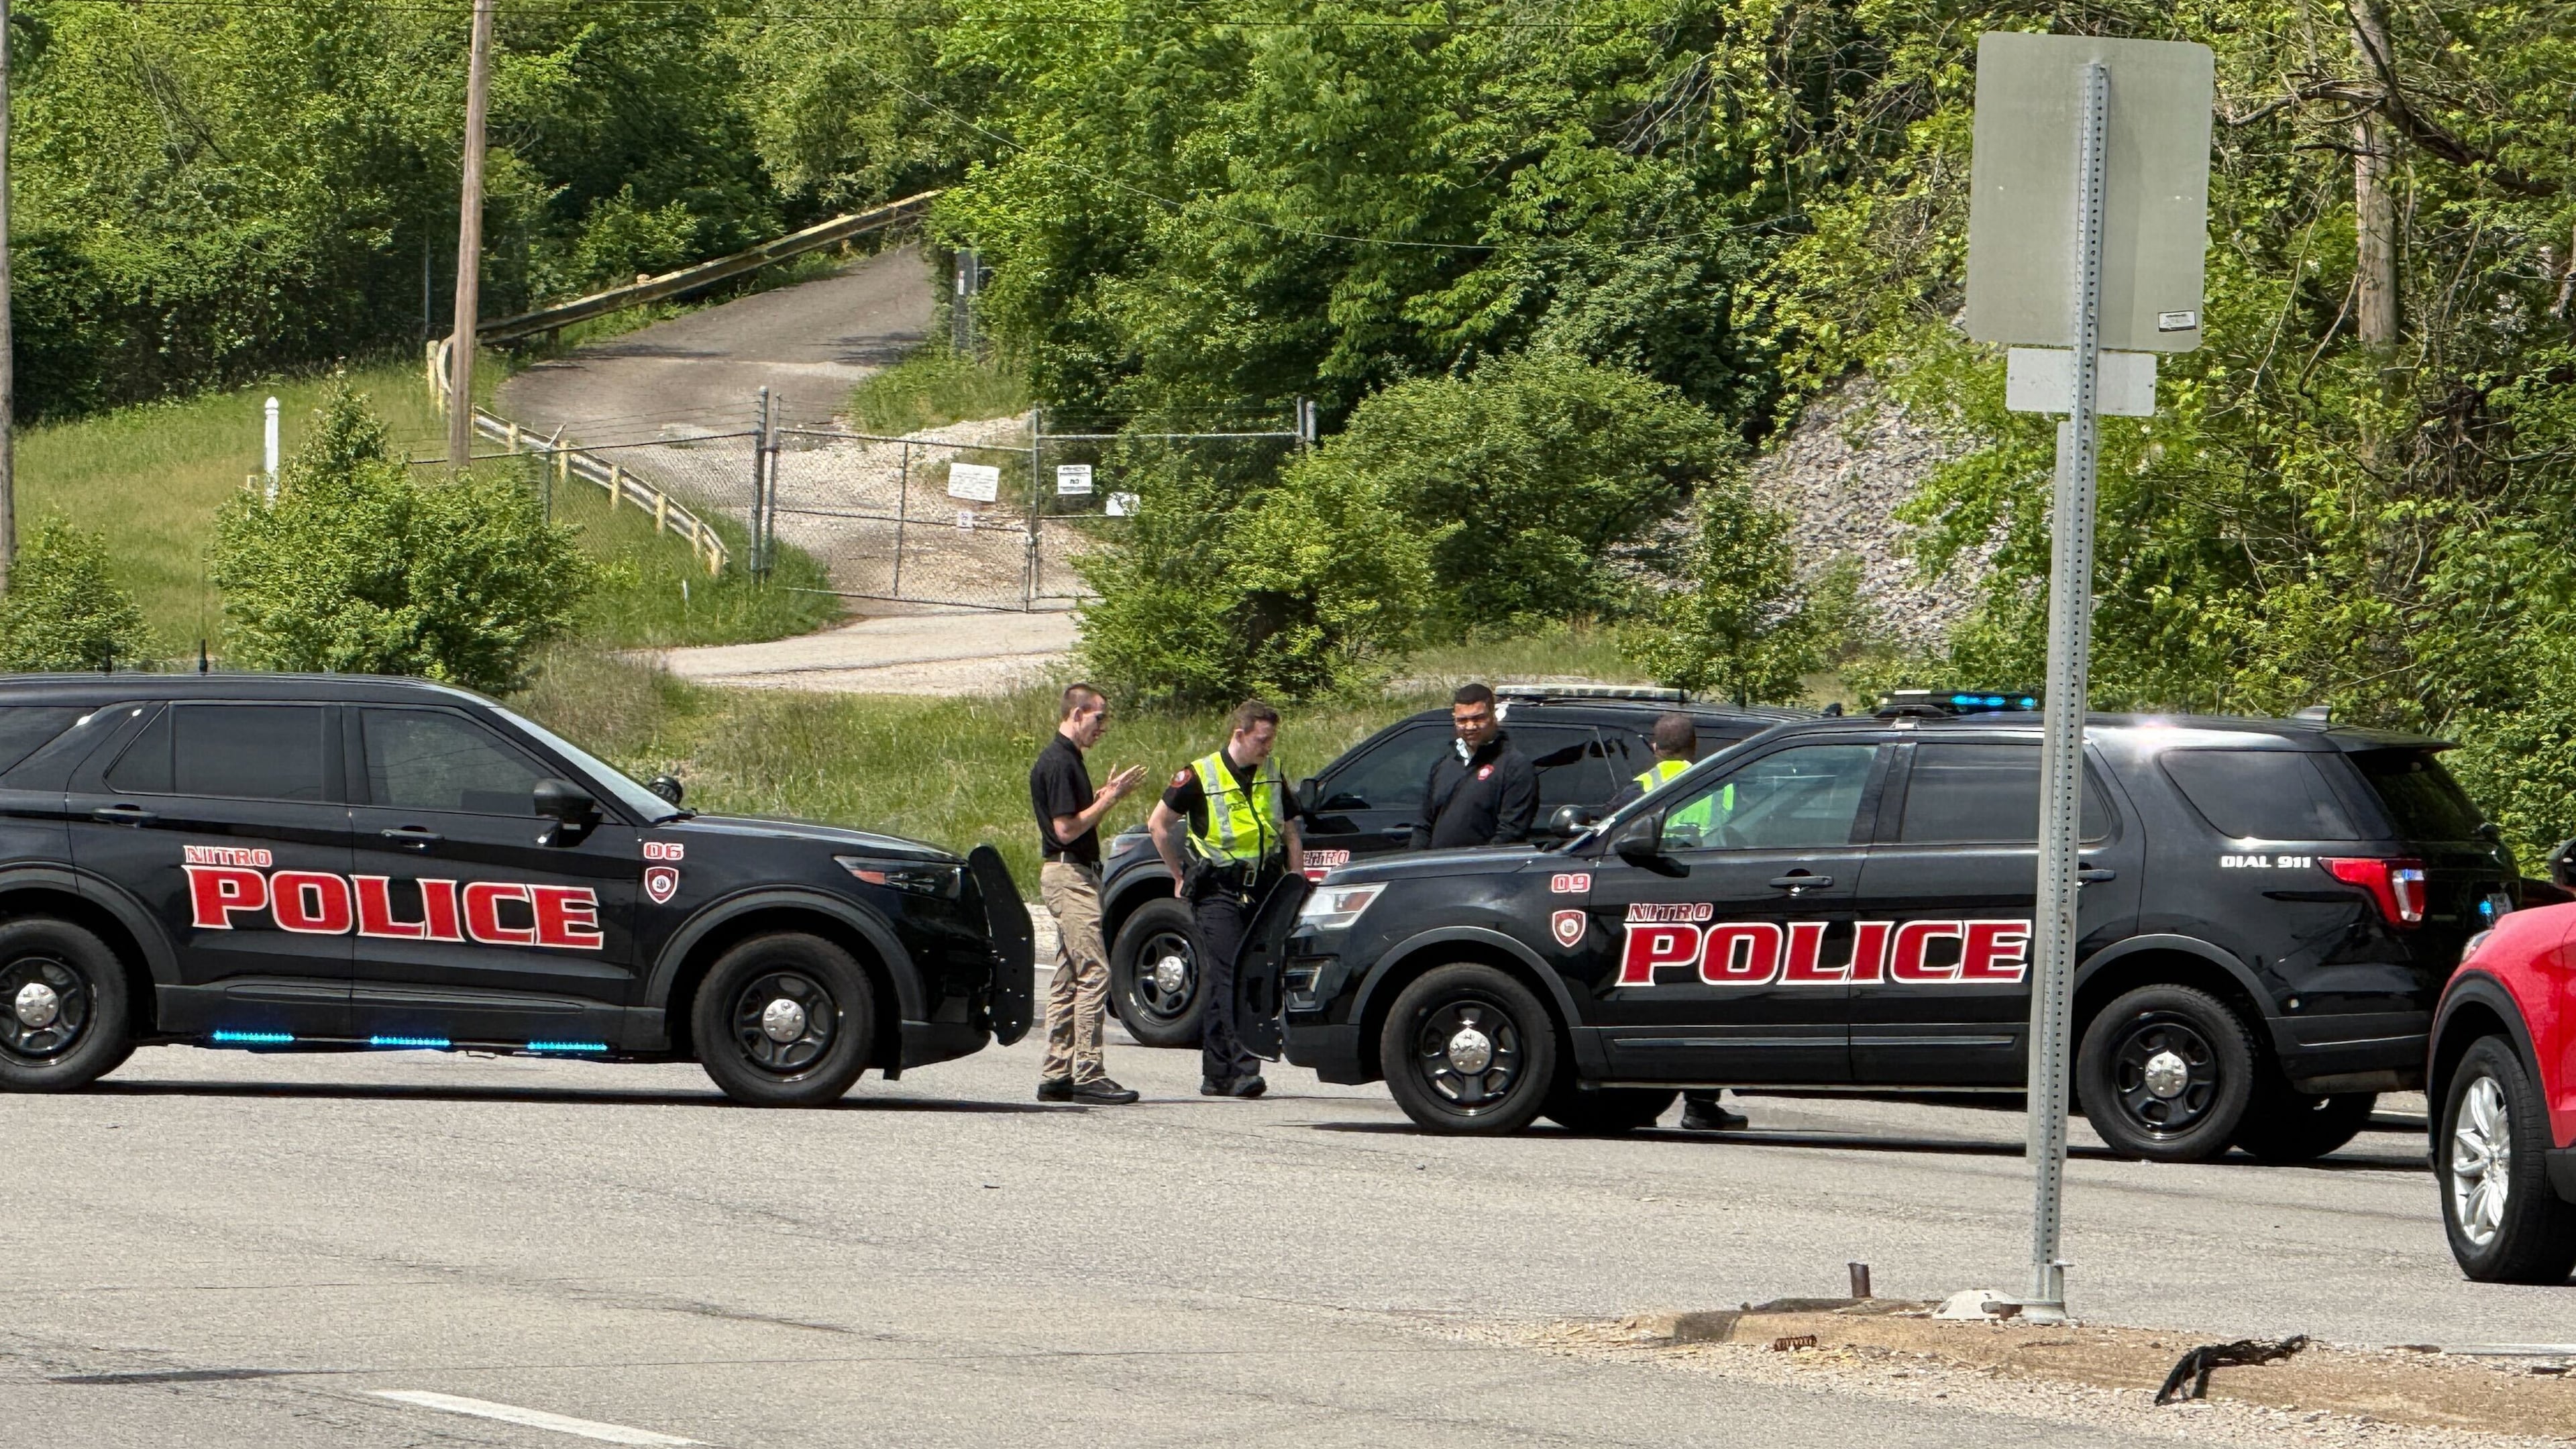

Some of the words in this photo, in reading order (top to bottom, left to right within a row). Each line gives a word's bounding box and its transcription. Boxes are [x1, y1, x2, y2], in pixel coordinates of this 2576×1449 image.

[183, 845, 272, 867] NITRO
[643, 842, 684, 860] 06
[2221, 855, 2272, 868] DIAL
[2277, 855, 2311, 868] 911
[1552, 873, 1591, 893] 09
[181, 865, 604, 949] POLICE
[1625, 903, 1713, 922] NITRO
[1615, 919, 2031, 987] POLICE
